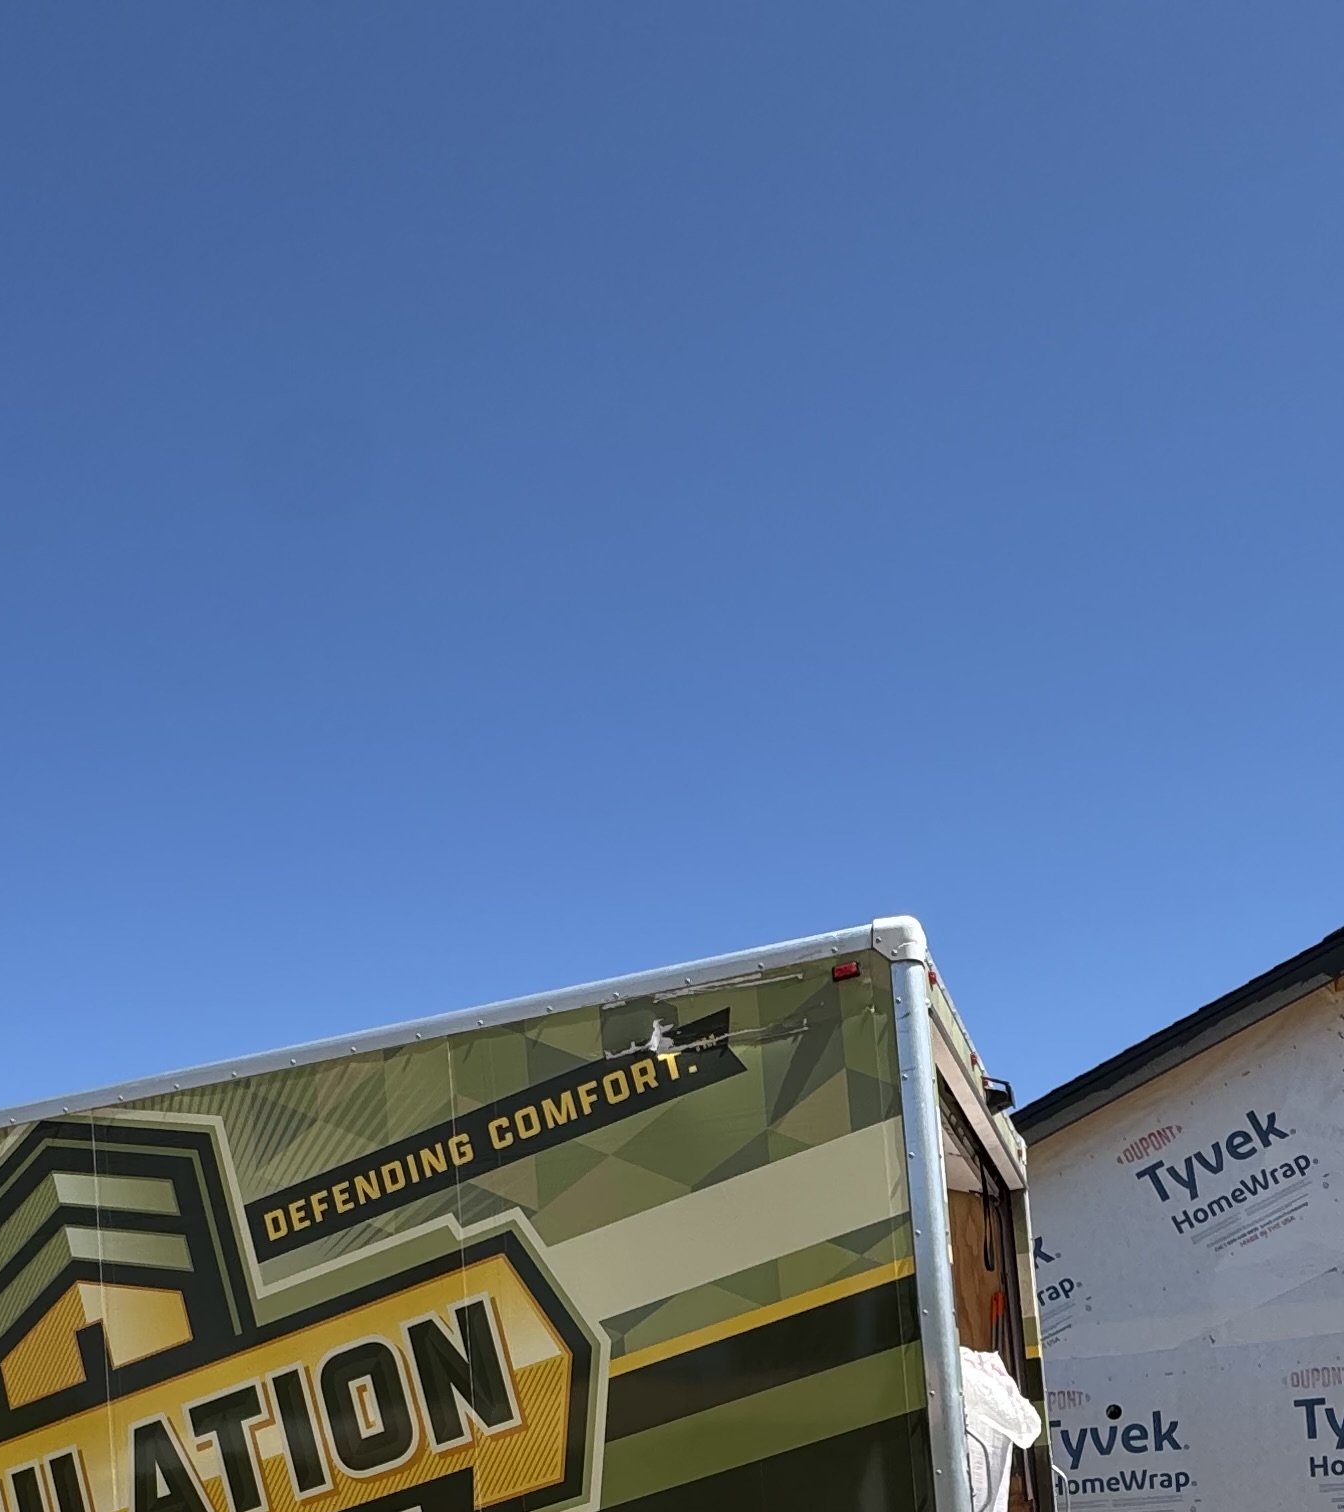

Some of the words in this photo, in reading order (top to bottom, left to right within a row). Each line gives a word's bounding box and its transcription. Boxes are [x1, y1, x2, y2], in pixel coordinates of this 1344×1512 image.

[263, 1133, 474, 1242] DEFENDING
[488, 1050, 698, 1150] COMFORT.
[1123, 1125, 1176, 1164] DUPONT
[1135, 1110, 1289, 1202] Tyvek
[1171, 1155, 1310, 1234] HomeWrap
[1048, 1391, 1082, 1412] PONT
